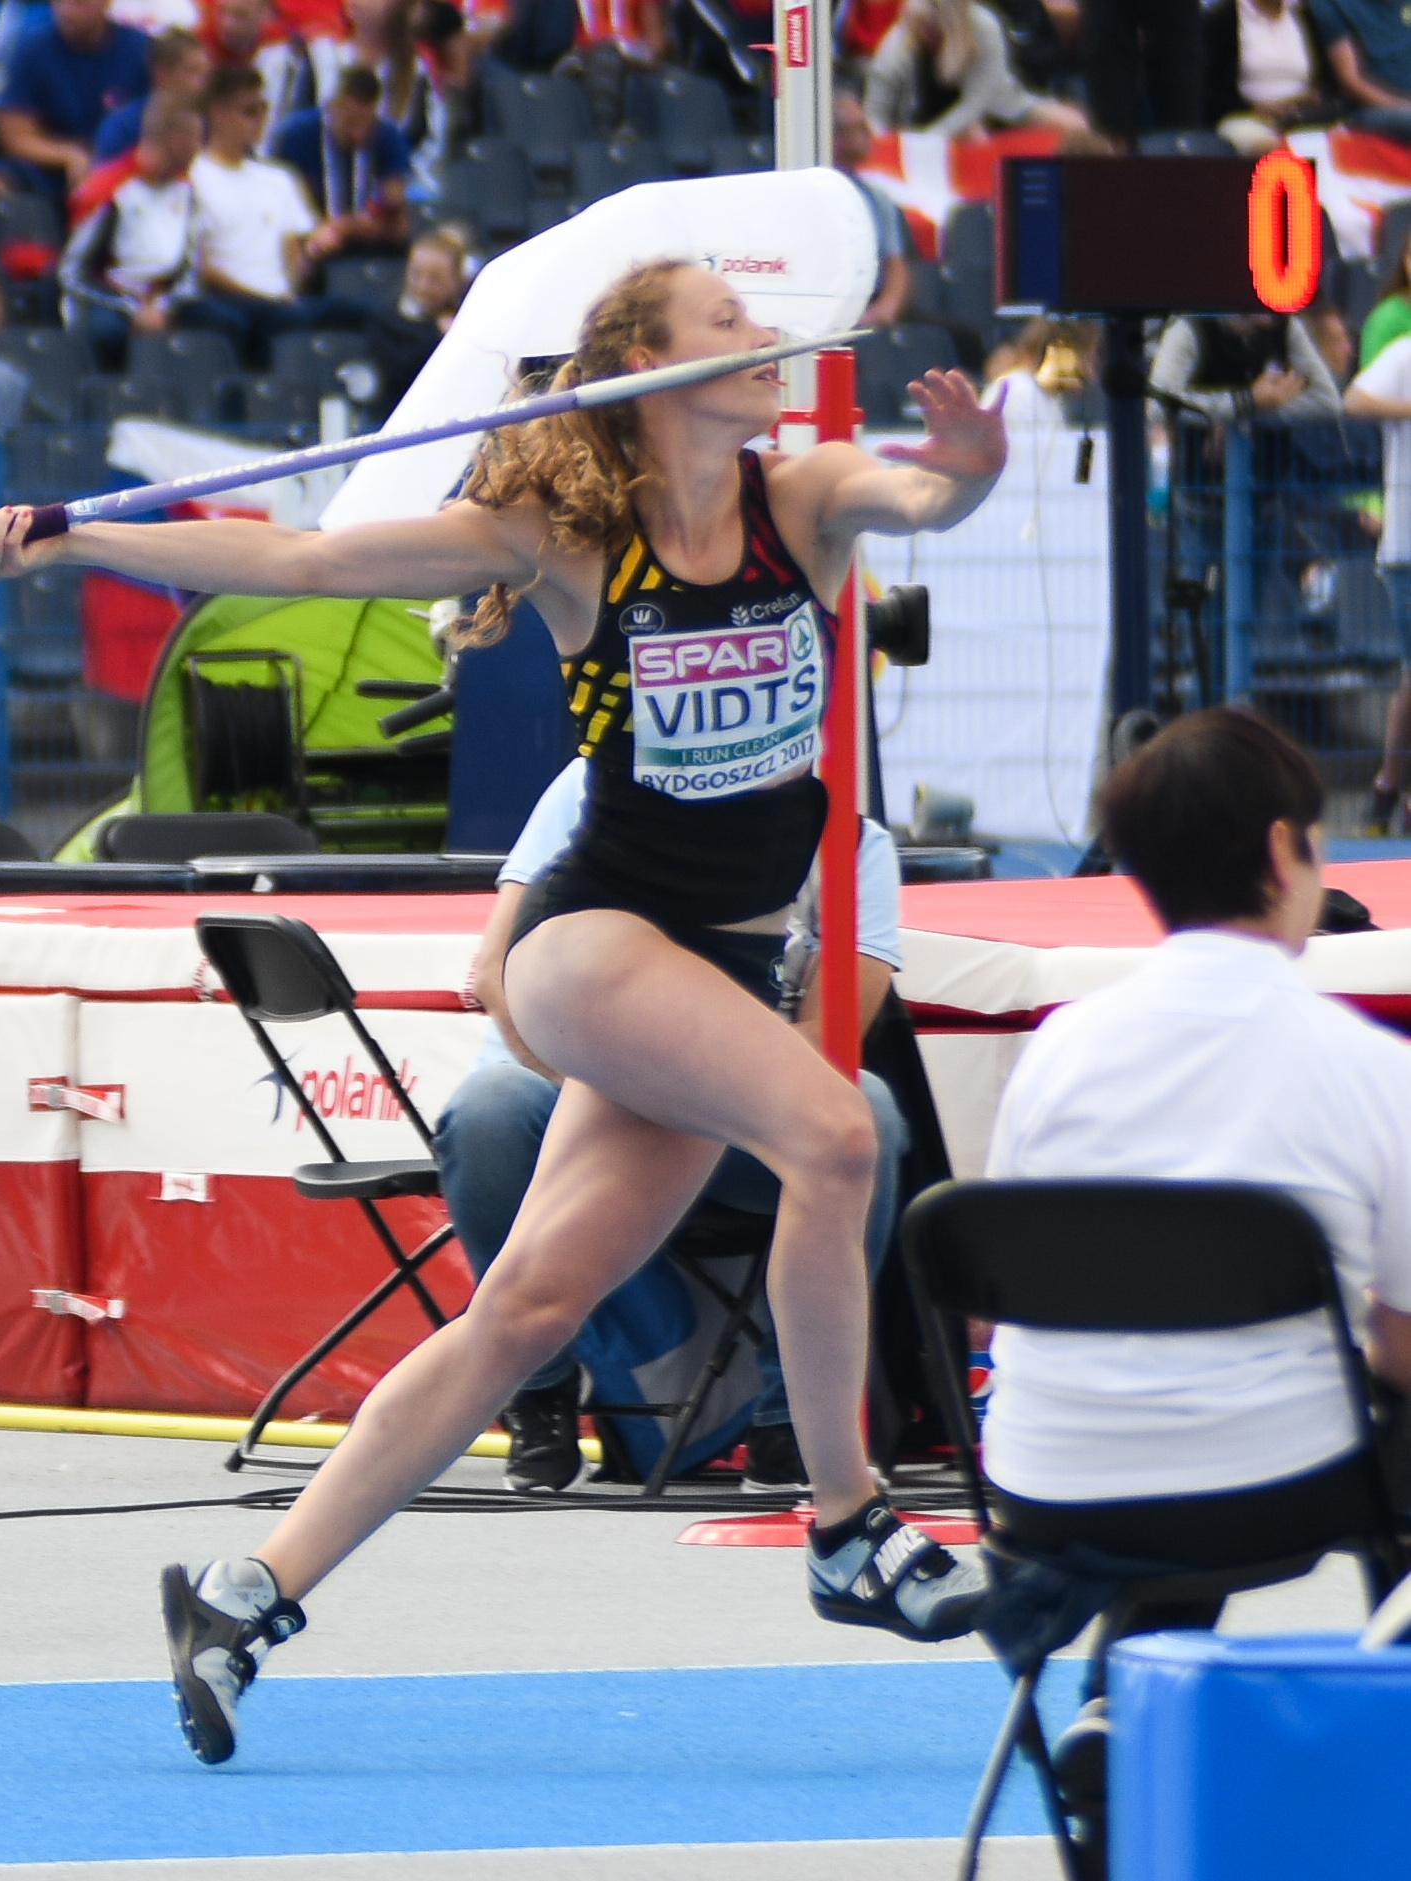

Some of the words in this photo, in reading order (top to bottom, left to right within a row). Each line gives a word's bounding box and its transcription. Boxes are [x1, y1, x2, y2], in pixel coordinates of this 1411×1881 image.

[1248, 149, 1321, 313] 0
[750, 592, 800, 620] Crelan
[638, 636, 785, 681] SPAR
[644, 663, 817, 738] VIDTS
[641, 755, 777, 793] BYDGOSZCZ
[781, 733, 815, 766] 2017
[691, 746, 729, 764] RUN
[733, 733, 782, 757] CLEAN
[295, 1054, 418, 1133] polanik
[873, 1524, 927, 1585] NIKE
